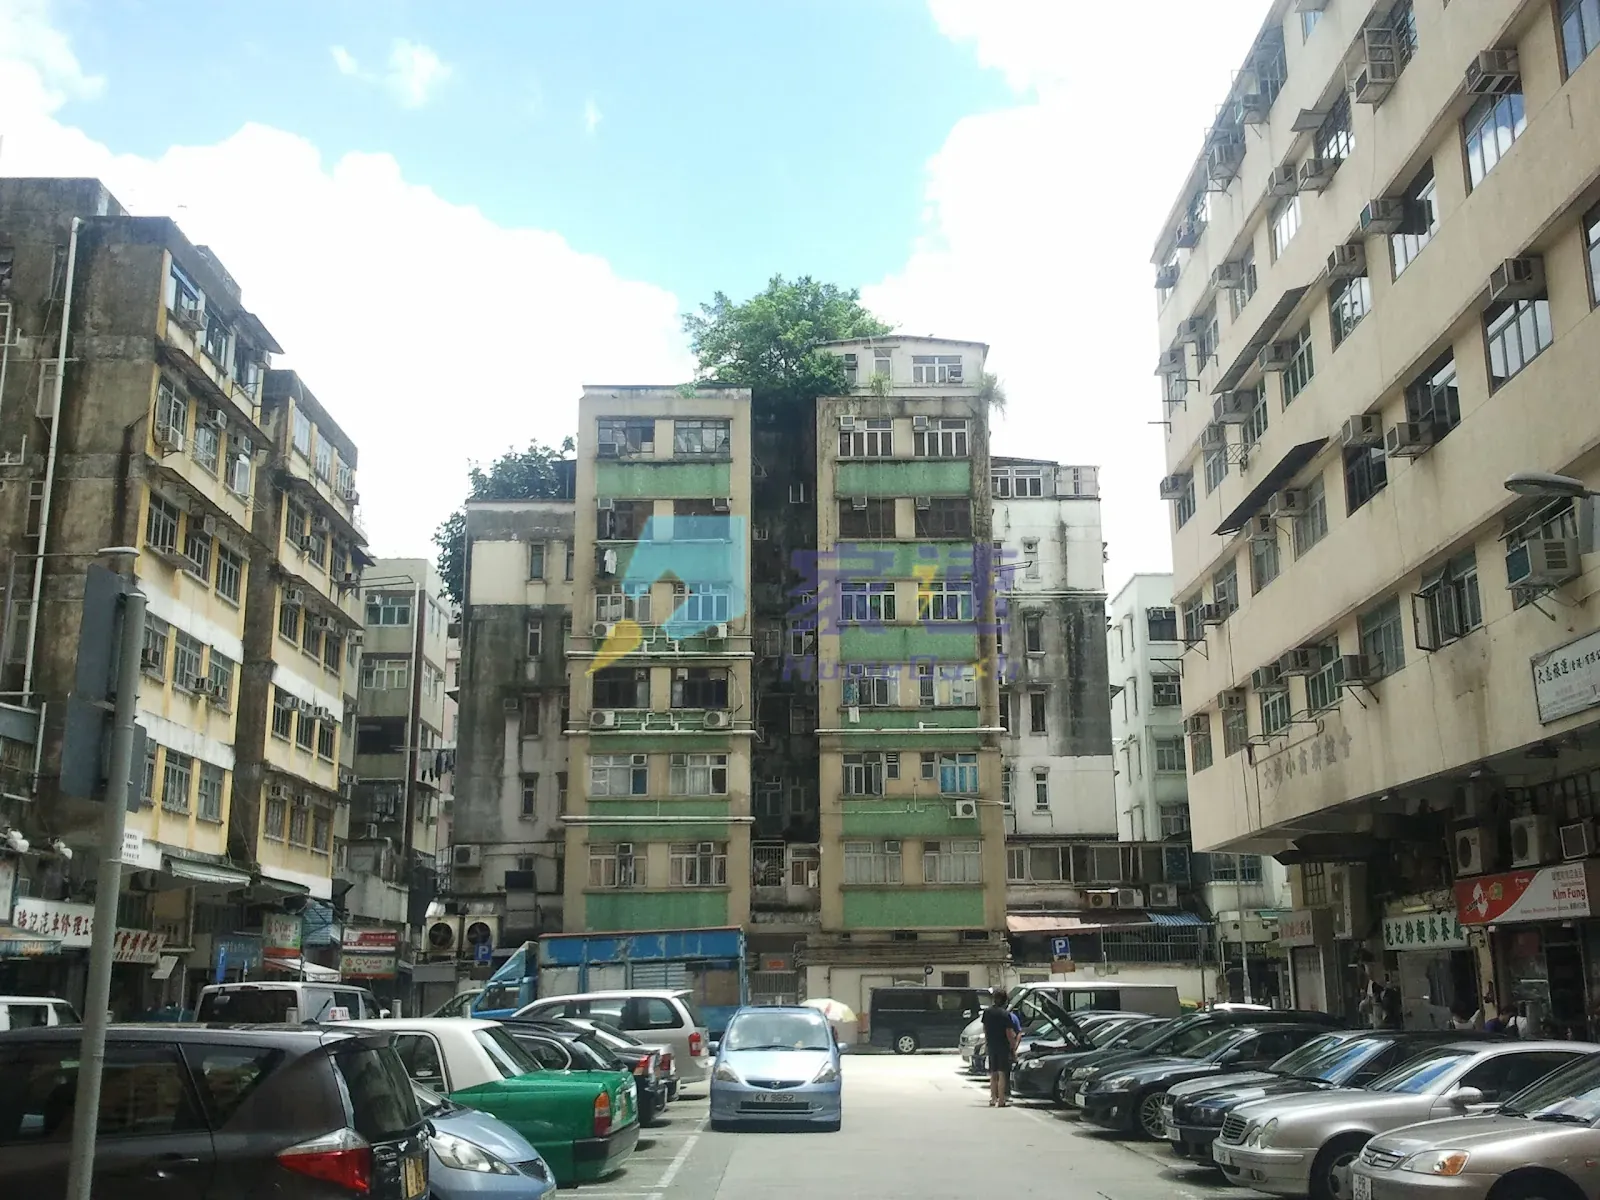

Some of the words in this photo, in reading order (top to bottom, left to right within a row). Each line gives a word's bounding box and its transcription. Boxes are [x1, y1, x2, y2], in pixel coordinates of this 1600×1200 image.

[1552, 887, 1567, 900] Kim
[1568, 886, 1586, 900] Fung
[478, 945, 489, 960] P
[1054, 939, 1066, 954] P
